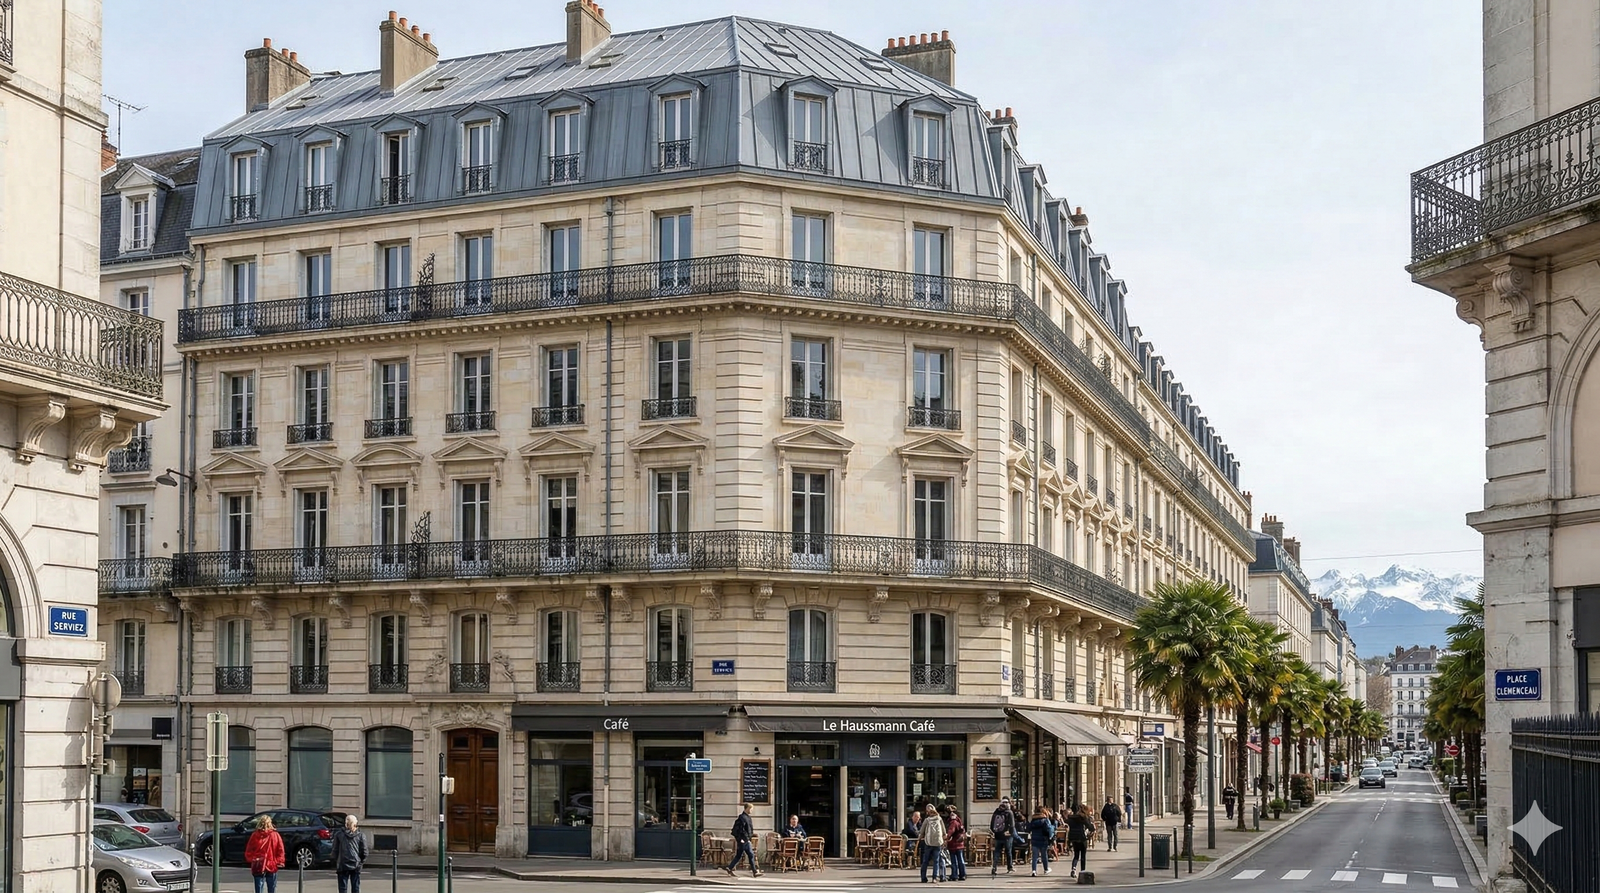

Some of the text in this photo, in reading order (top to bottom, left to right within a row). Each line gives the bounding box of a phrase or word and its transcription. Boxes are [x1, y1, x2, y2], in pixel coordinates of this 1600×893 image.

[62, 612, 76, 620] RUE
[54, 622, 84, 631] SERVIEZ
[1506, 675, 1528, 683] PLACE
[1496, 686, 1538, 696] CLEMENCEAU
[603, 718, 629, 729] Café
[823, 719, 936, 732] Le Haussmann Café
